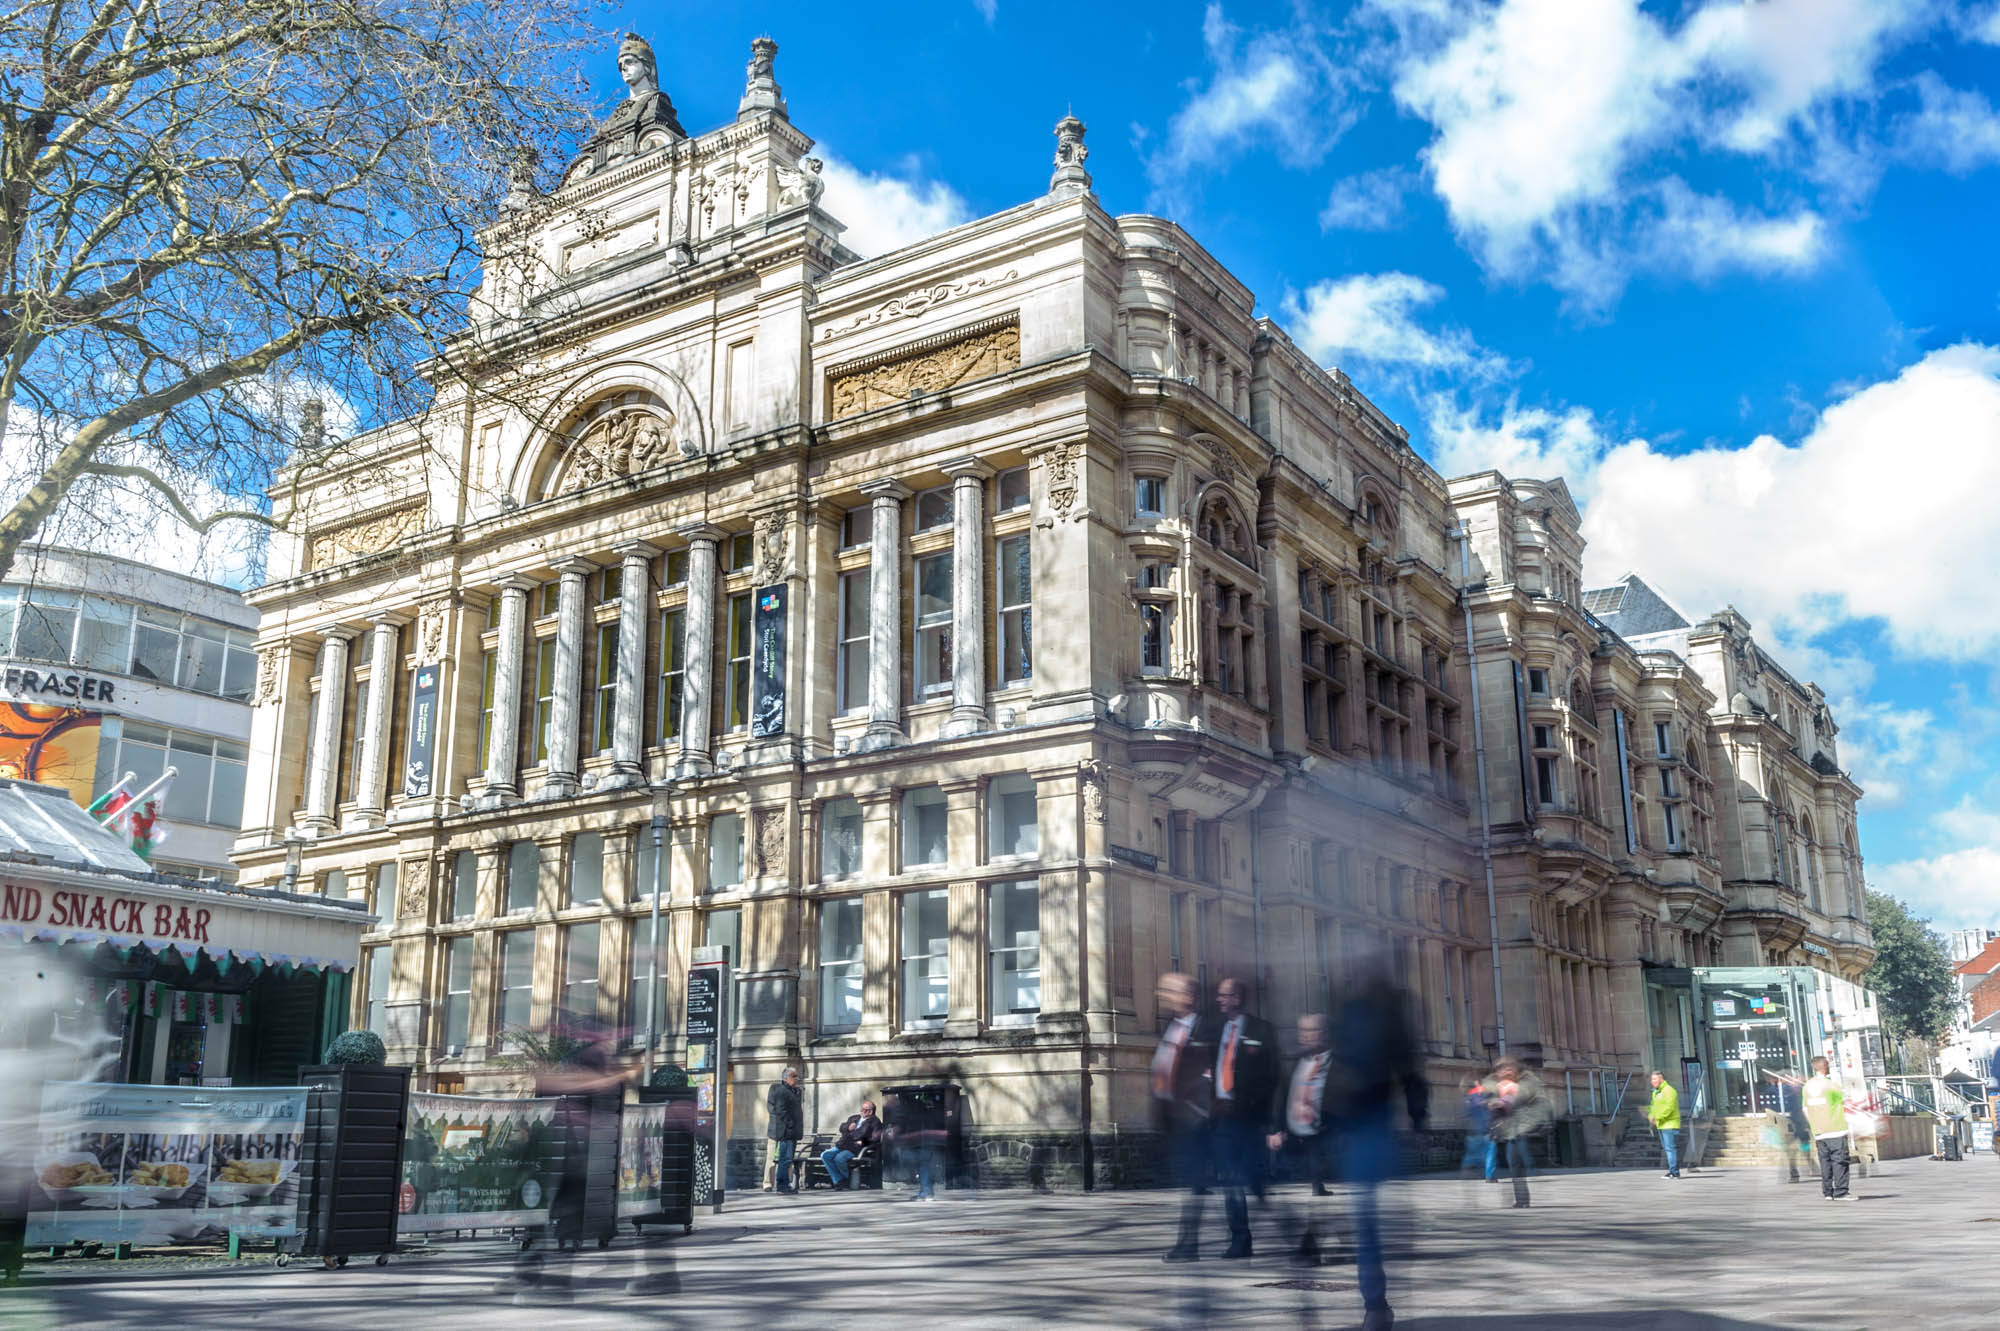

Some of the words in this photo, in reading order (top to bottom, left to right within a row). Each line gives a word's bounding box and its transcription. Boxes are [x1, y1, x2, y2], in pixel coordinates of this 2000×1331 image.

[4, 668, 115, 703] FRASER
[48, 891, 148, 934] SNACK
[153, 904, 211, 944] BAR
